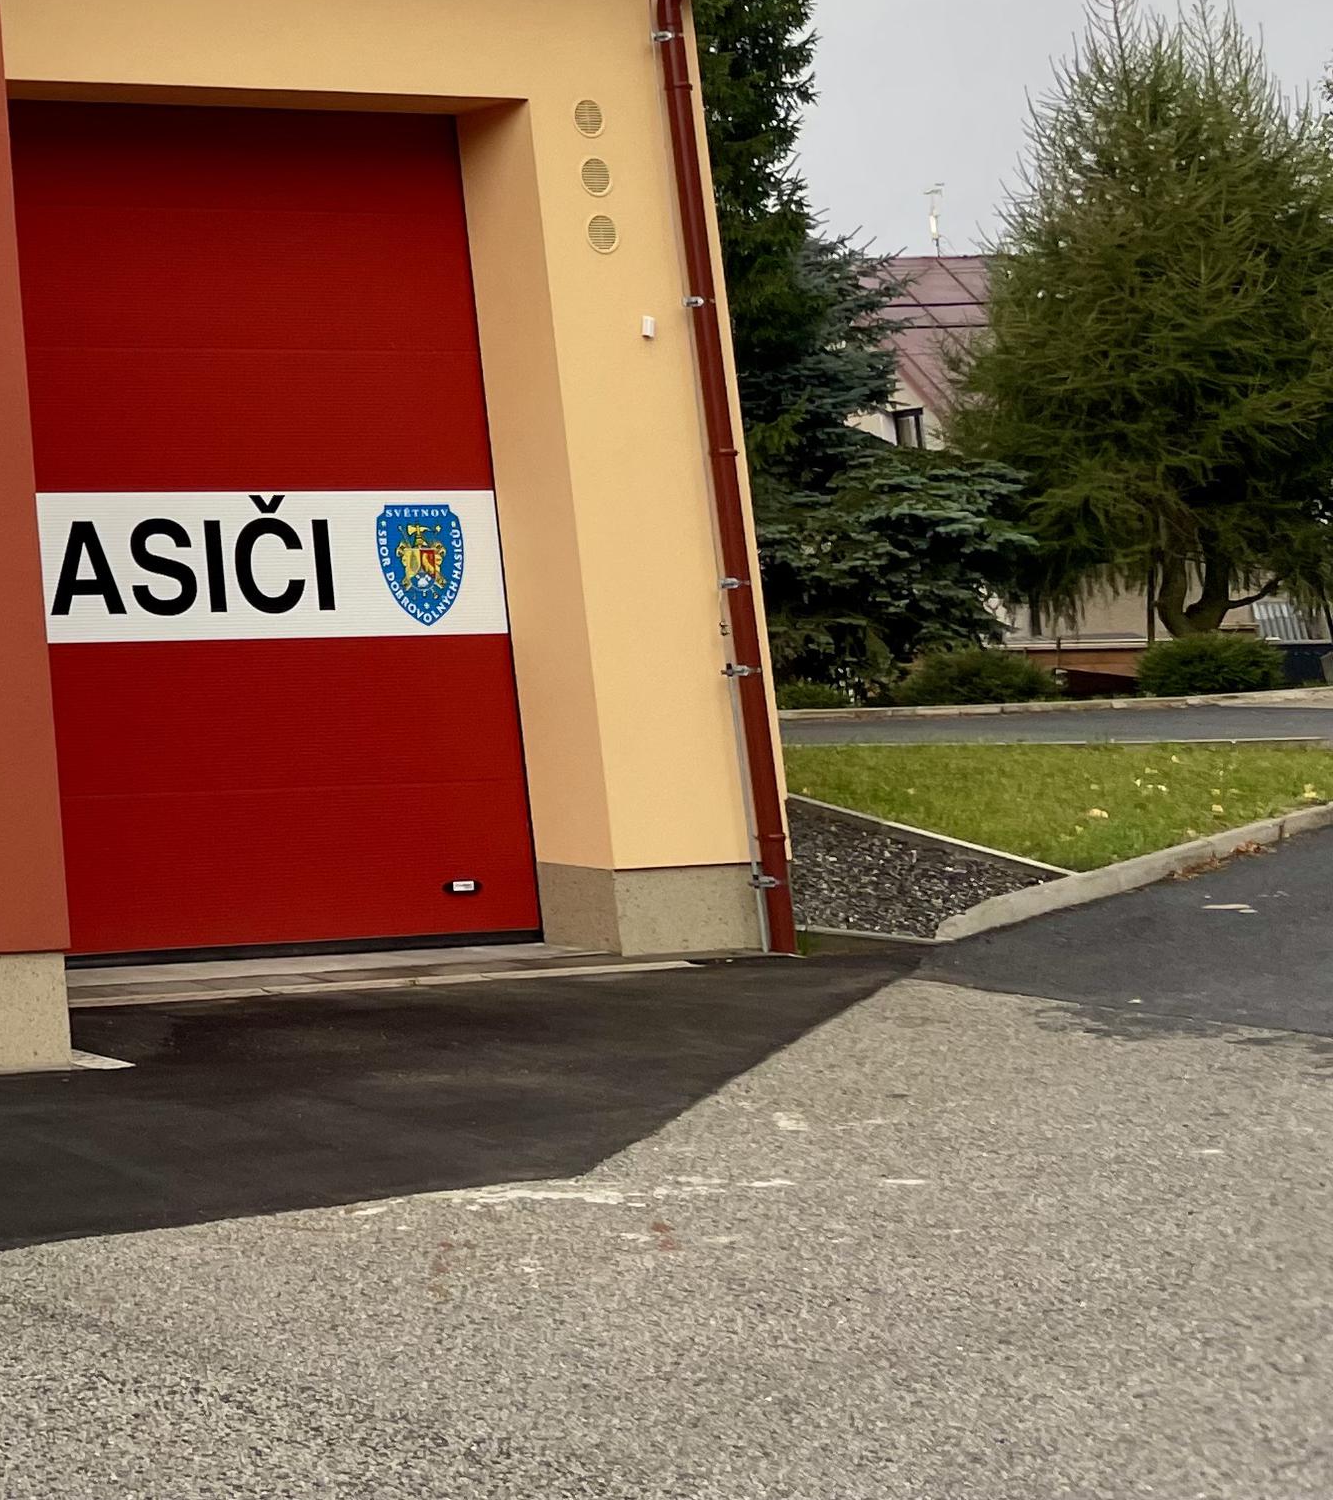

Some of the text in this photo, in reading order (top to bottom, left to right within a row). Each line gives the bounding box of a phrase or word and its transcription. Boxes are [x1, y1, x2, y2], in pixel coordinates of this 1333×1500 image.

[51, 495, 336, 616] ASIČI
[385, 508, 448, 517] SVĚTNOV
[378, 529, 463, 622] SBOR DOBROVOLNÝCH HASIČŮ
